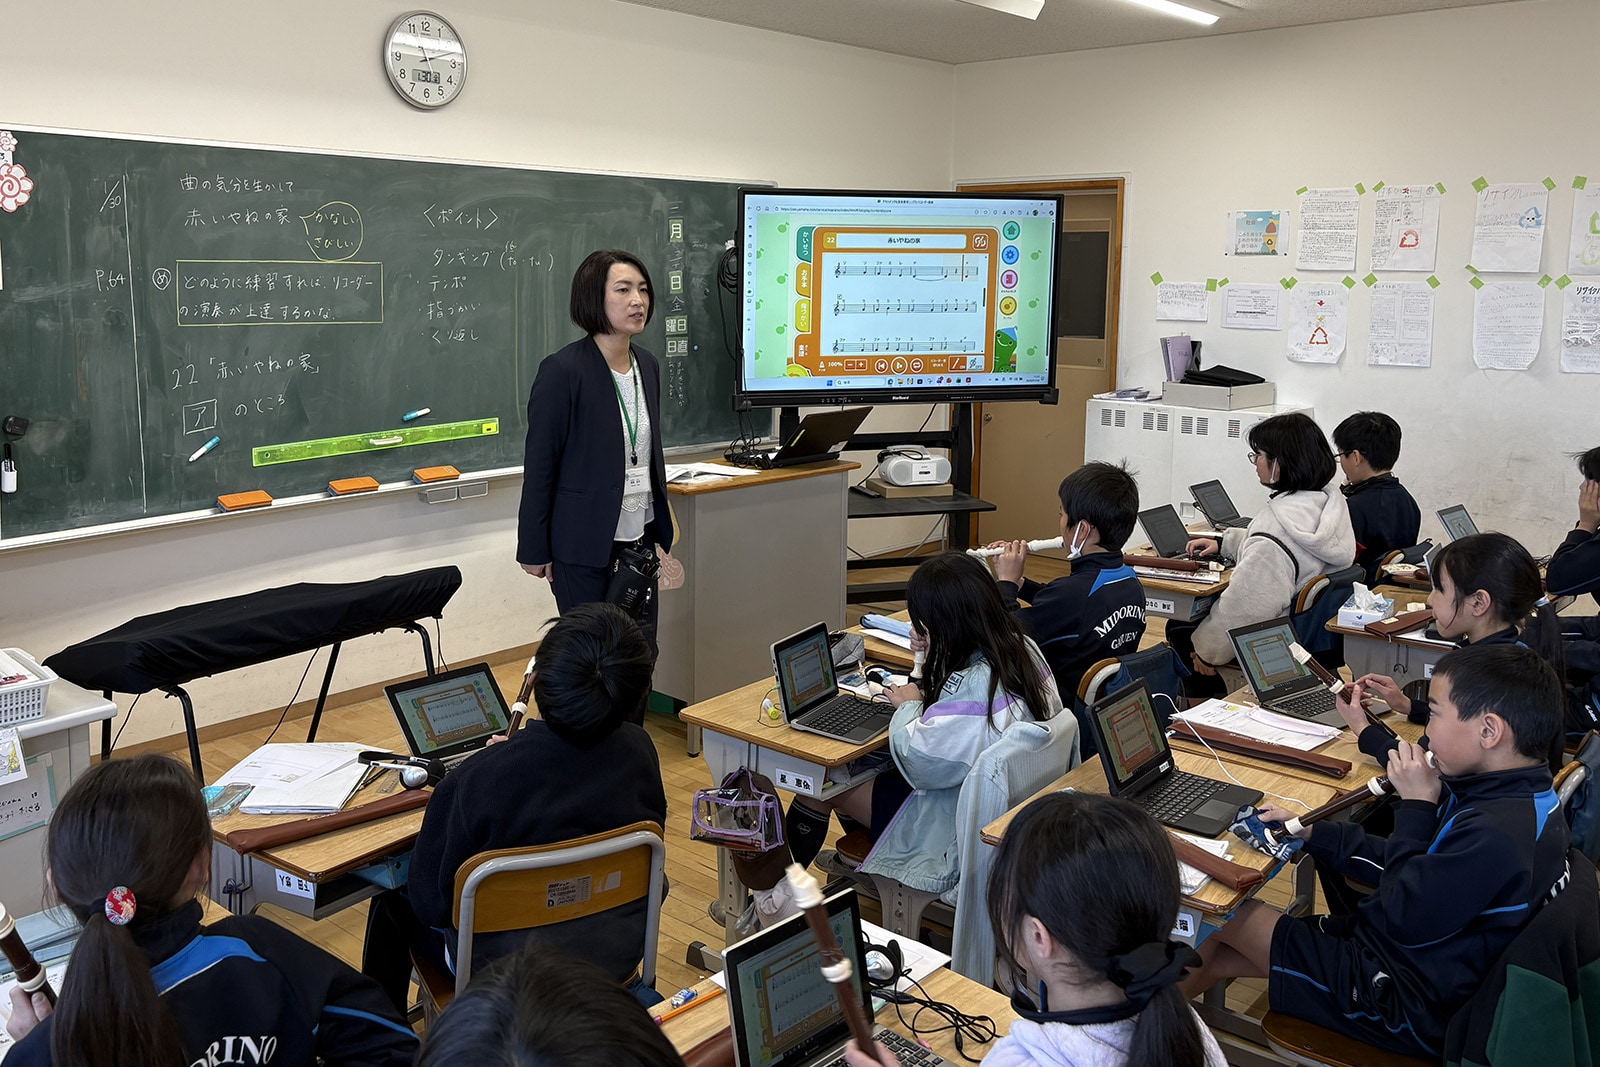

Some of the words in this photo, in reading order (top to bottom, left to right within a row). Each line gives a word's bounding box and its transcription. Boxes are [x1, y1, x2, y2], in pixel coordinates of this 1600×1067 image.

[408, 23, 416, 34] 11
[421, 21, 430, 32] 12
[395, 51, 402, 61] 9
[450, 59, 457, 69] 3
[400, 69, 406, 79] 8
[447, 75, 453, 85] 4
[410, 82, 416, 92] 7
[437, 85, 444, 96] 5
[424, 88, 430, 98] 6
[180, 173, 295, 193] 曲の気分を生かして
[184, 206, 291, 226] 赤いやねの家
[315, 209, 358, 225] かなしい
[313, 236, 354, 249] さびしい
[433, 248, 496, 267] タンギング
[429, 275, 467, 292] テンポ
[172, 365, 199, 390] 22
[234, 394, 286, 416] のところ
